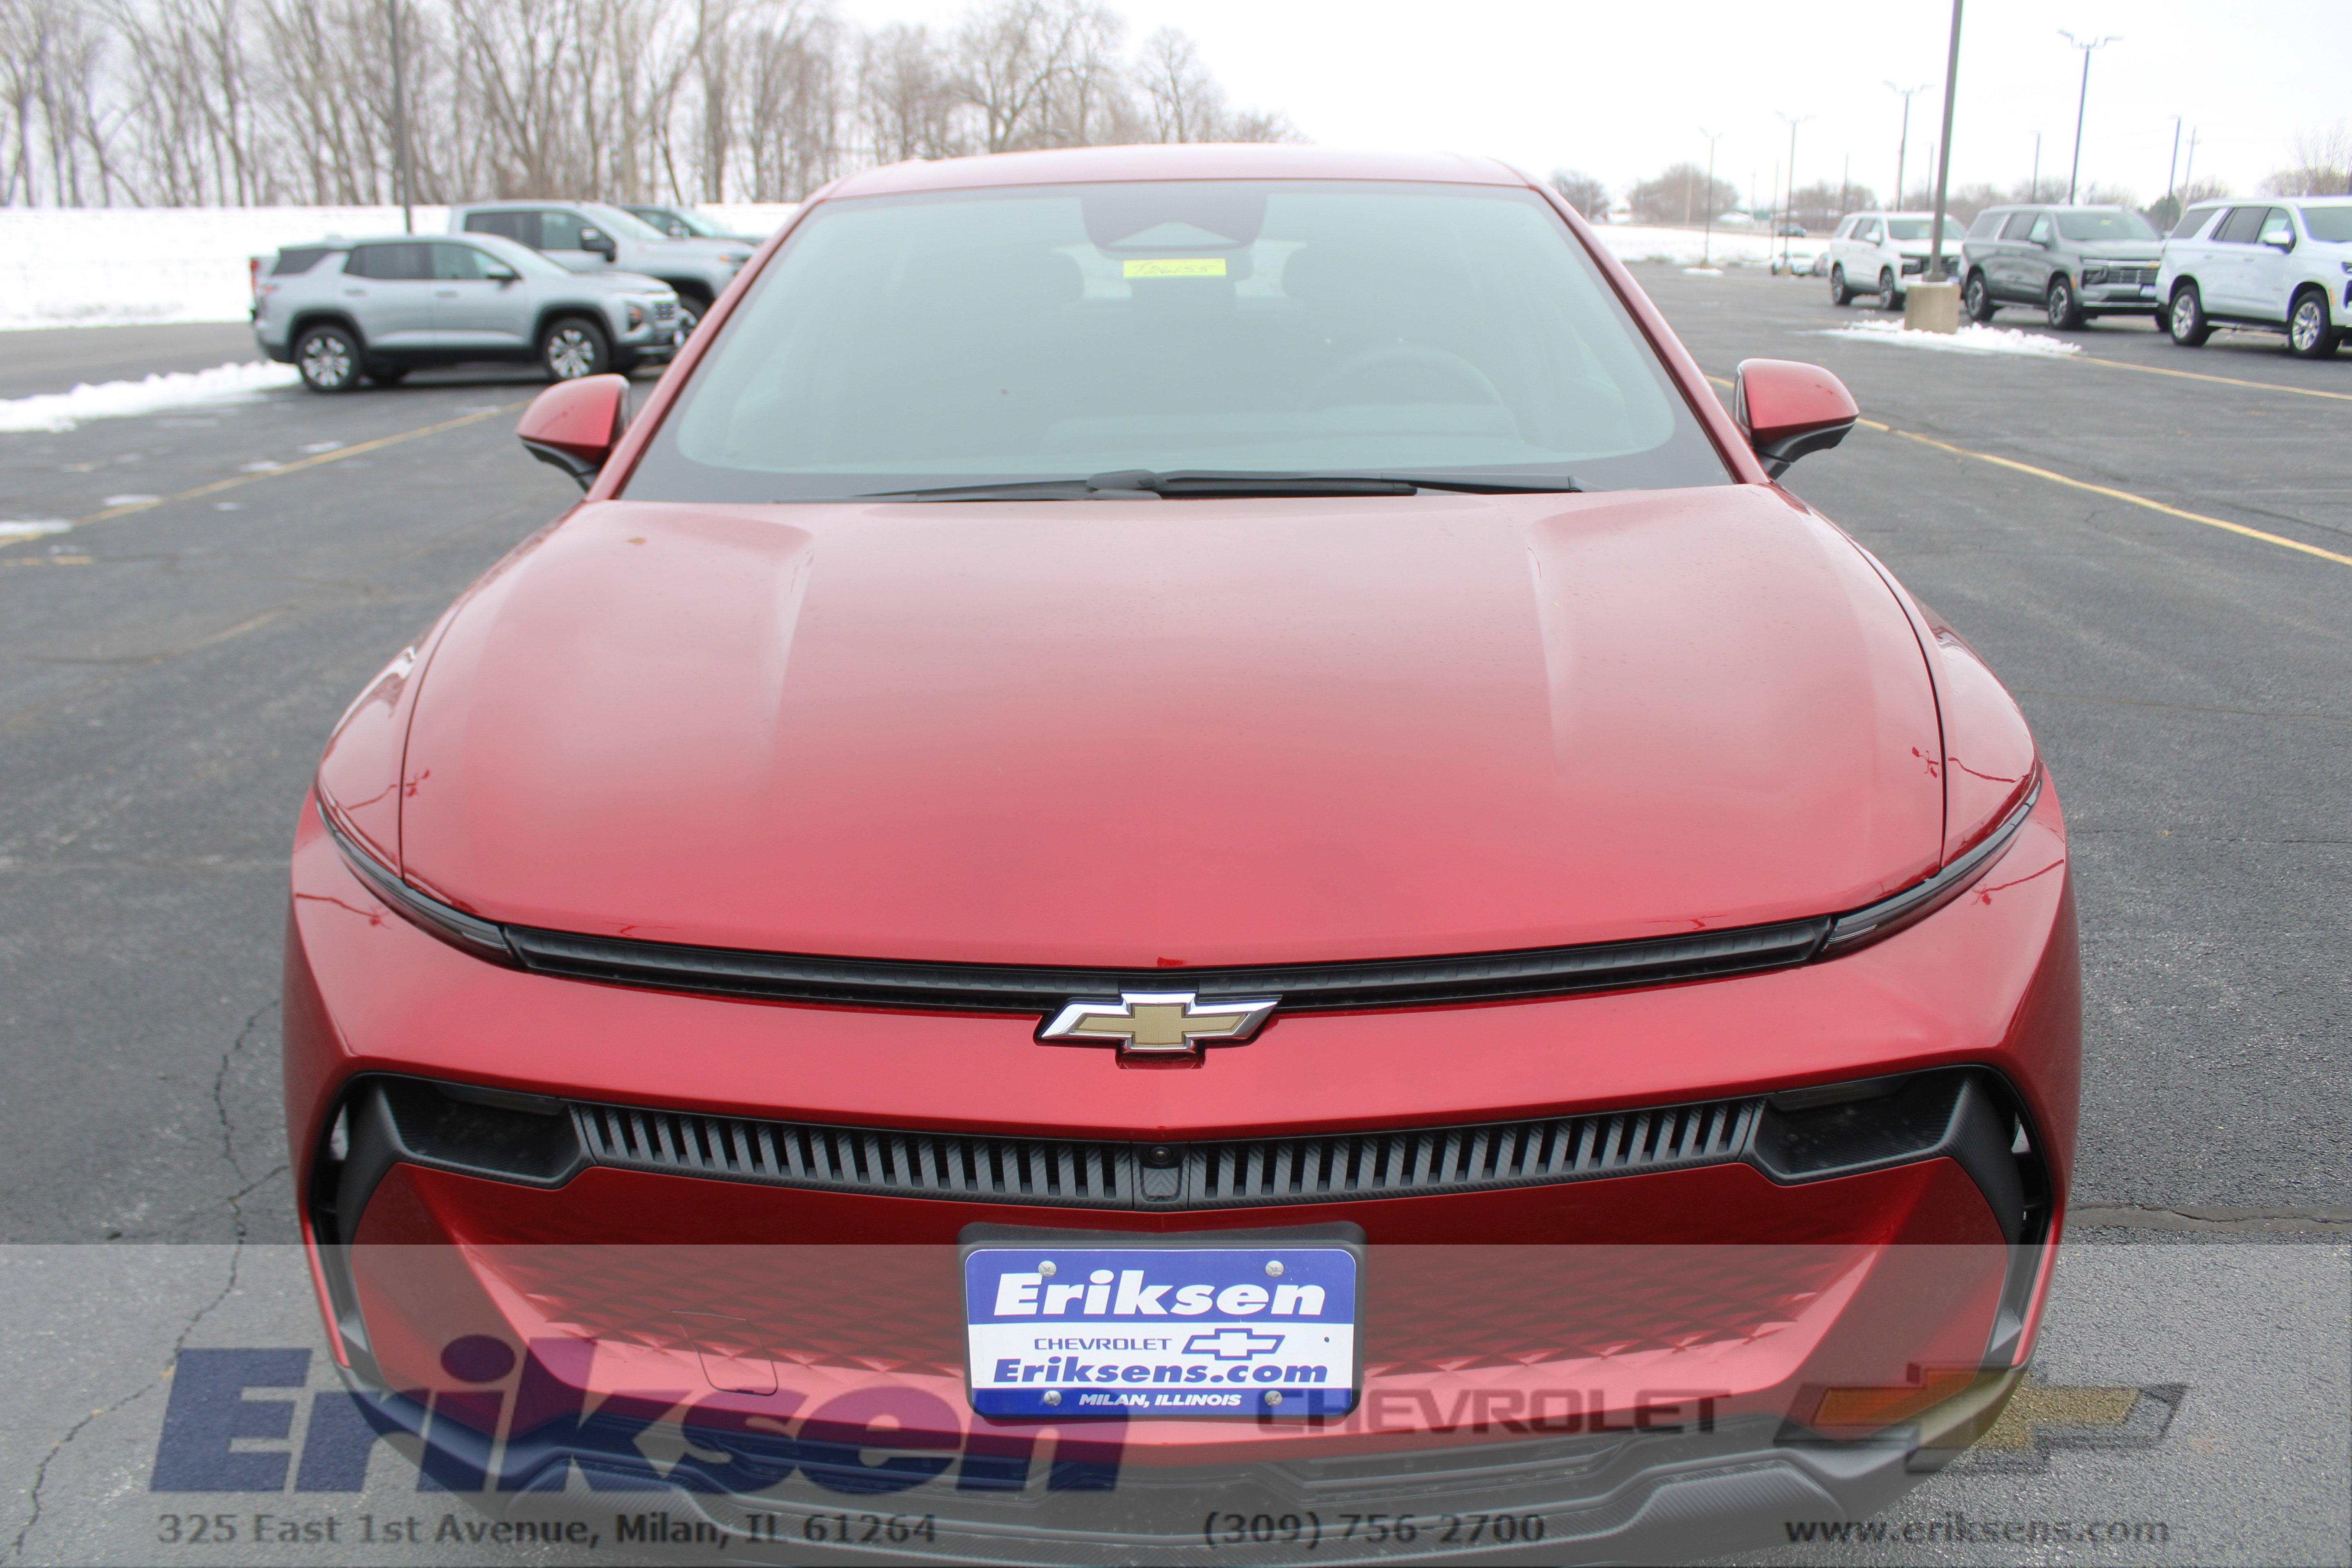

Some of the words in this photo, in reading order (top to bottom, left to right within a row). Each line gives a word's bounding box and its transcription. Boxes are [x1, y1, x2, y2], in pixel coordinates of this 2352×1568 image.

[993, 1269, 1326, 1316] Eriksen
[1034, 1338, 1172, 1350] CHEVROLET
[993, 1356, 1328, 1383] Eriksens.com
[1079, 1394, 1149, 1408] MILAN,
[1154, 1394, 1242, 1406] ILLINOIS
